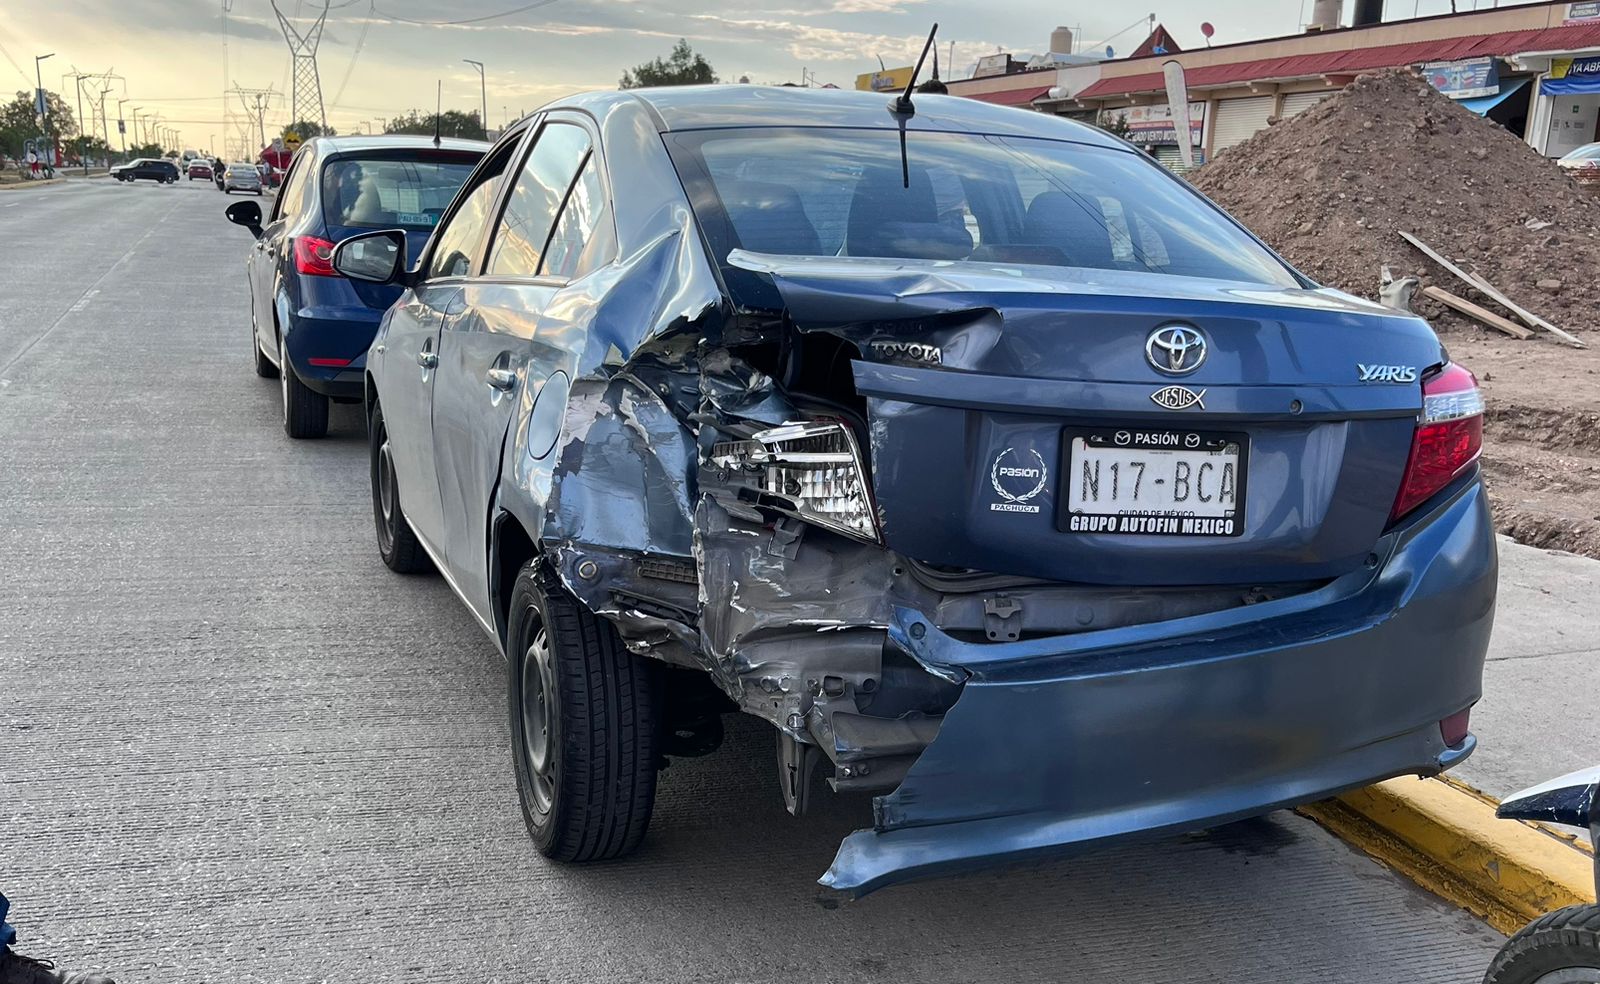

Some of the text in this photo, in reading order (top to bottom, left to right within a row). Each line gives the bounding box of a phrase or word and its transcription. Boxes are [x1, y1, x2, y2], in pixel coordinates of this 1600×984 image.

[1158, 388, 1192, 406] JESUS
[1135, 432, 1179, 446] PASIÓN
[1081, 459, 1235, 503] N17-BCA
[994, 504, 1036, 512] PACHUCA
[1070, 515, 1235, 535] GRUPO AUTOFIN MEXICO
